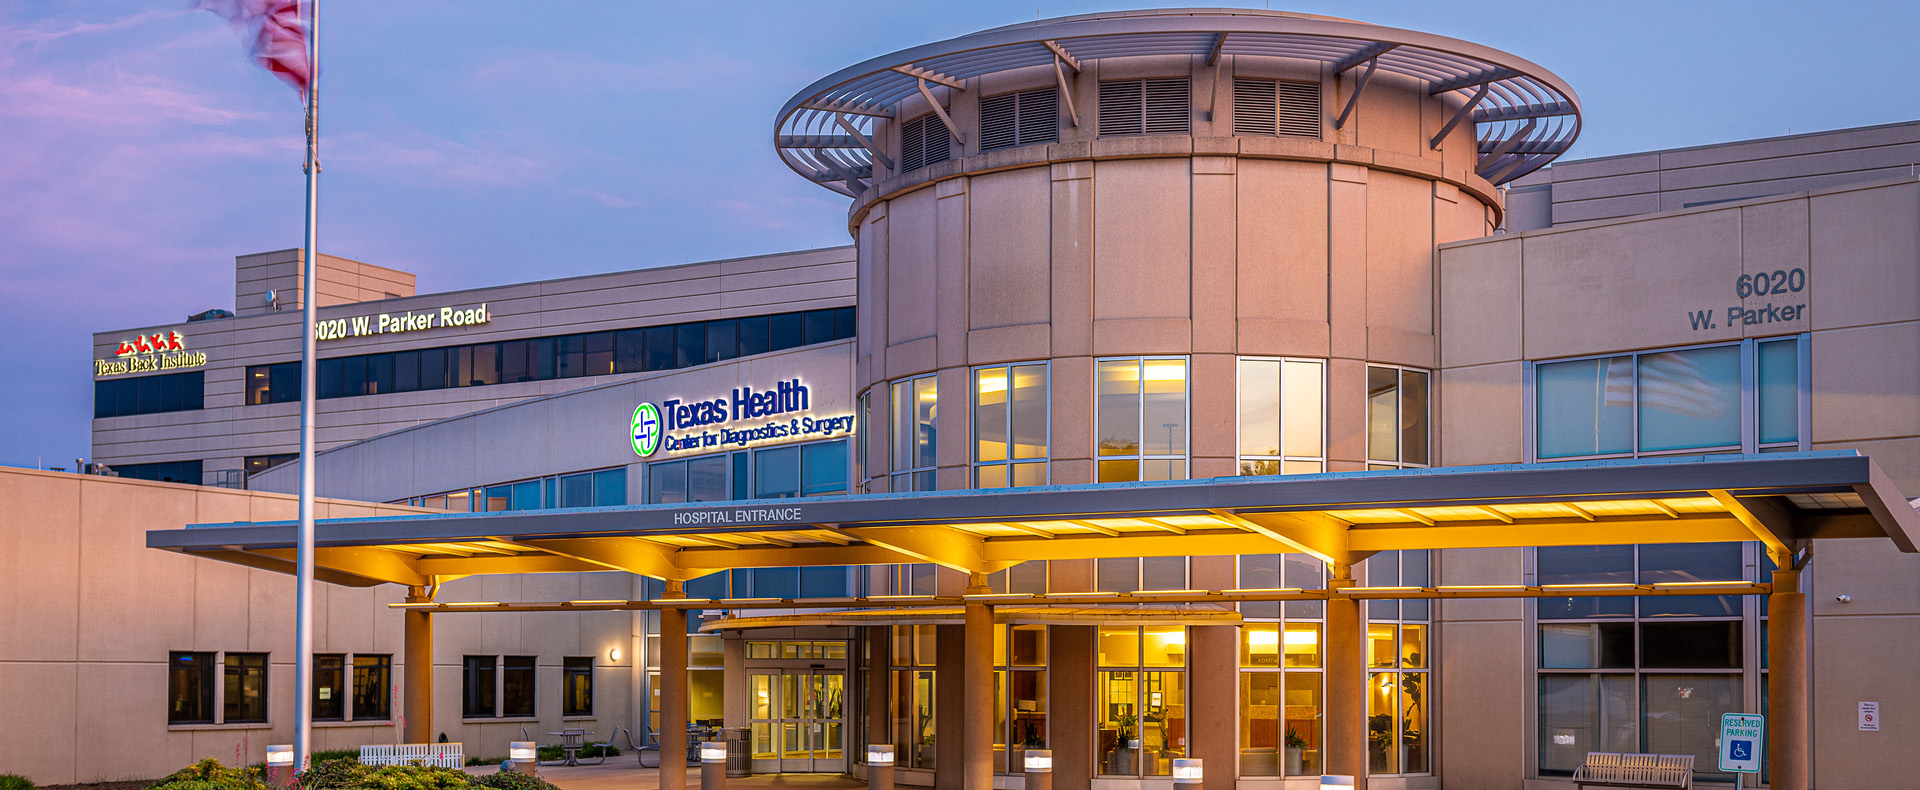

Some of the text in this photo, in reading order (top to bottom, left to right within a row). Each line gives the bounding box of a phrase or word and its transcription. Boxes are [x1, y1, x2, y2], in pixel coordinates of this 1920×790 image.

[1736, 267, 1806, 299] 6020
[351, 315, 373, 337] W.
[378, 311, 437, 334] Parker
[440, 303, 488, 328] Road
[1688, 303, 1806, 331] W. Parker
[94, 350, 207, 376] Texas Back Institute
[663, 378, 809, 431] Texas Health
[664, 415, 855, 452] Center for Diagnostics & Surgery
[674, 507, 802, 525] HOSPITAL ENTRANCE
[1724, 718, 1761, 728] RESERVED
[1726, 728, 1758, 738] PARKING
